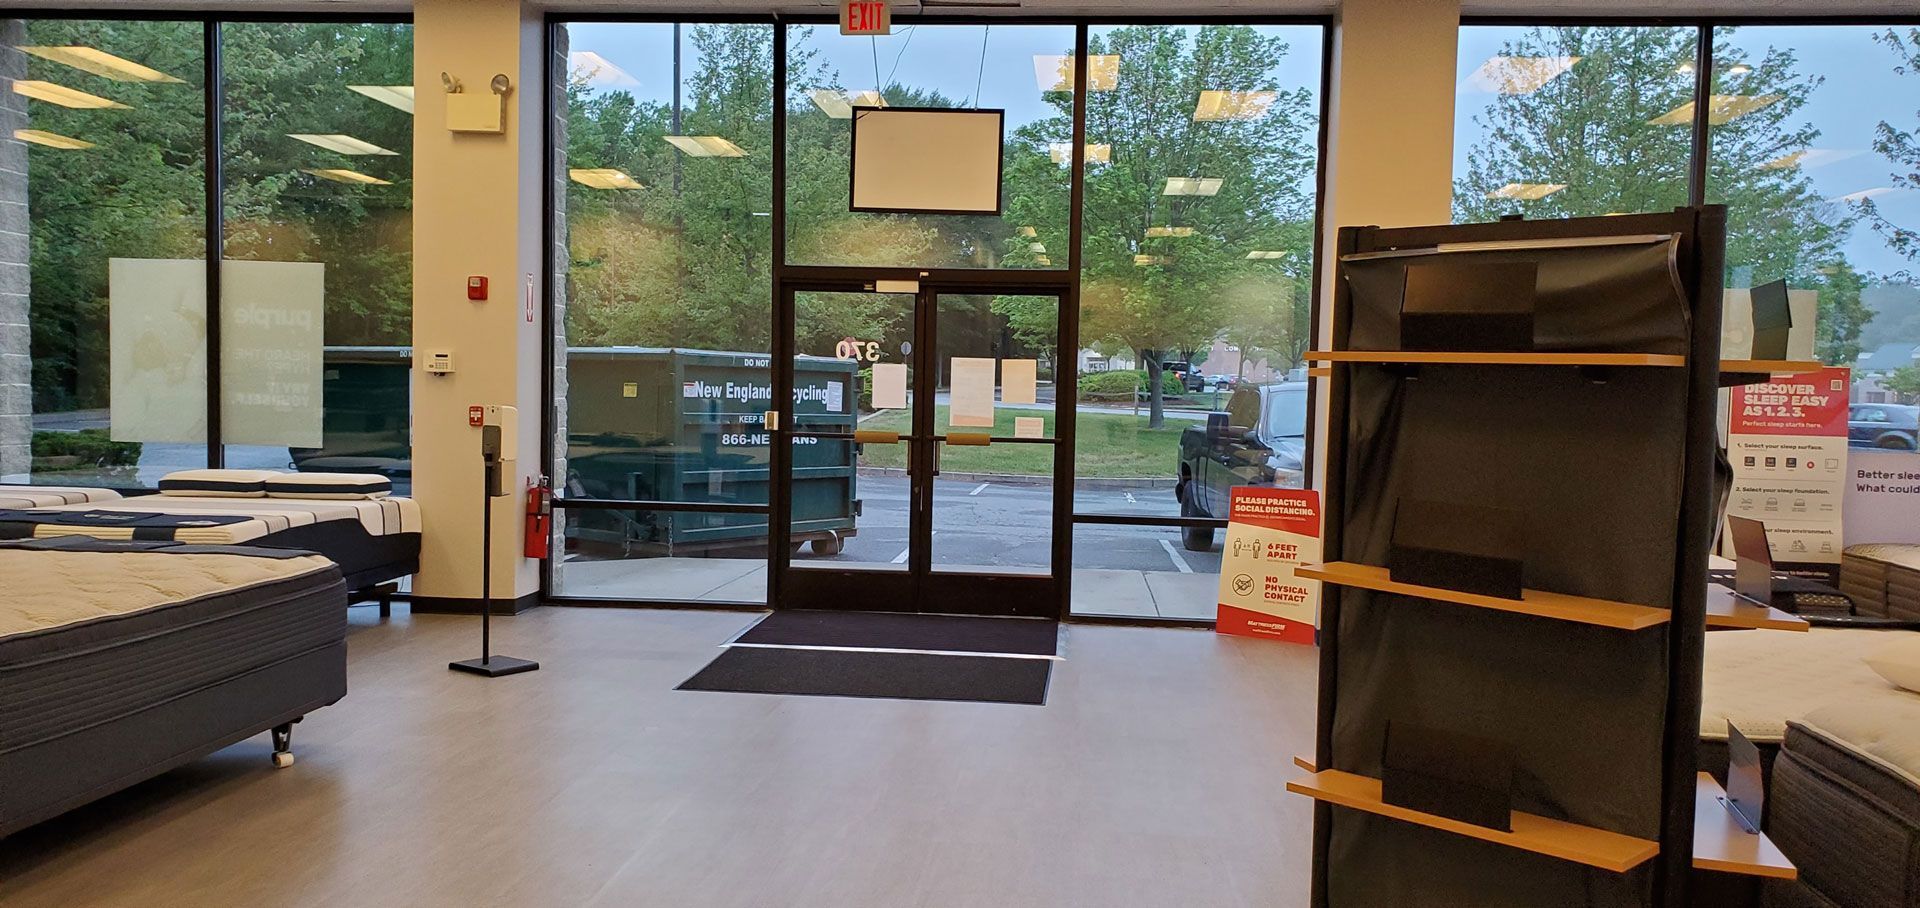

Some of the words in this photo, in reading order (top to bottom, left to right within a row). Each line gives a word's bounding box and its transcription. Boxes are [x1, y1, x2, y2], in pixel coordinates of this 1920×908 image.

[848, 2, 884, 31] EXIT
[744, 358, 754, 367] DO
[755, 359, 770, 367] NOT
[695, 380, 722, 398] New
[726, 382, 772, 403] England
[793, 386, 829, 405] cycling
[1744, 383, 1815, 395] DISCOVER
[1743, 395, 1788, 406] SLEEP
[1791, 395, 1829, 407] EASY
[1742, 405, 1763, 416] AS
[1764, 406, 1775, 417] 1.
[1776, 406, 1791, 417] 2.
[1791, 407, 1806, 418] 3.
[739, 415, 758, 424] KEEP
[721, 433, 818, 445] 866-NEANS
[1857, 469, 1896, 480] Better
[1897, 471, 1920, 480] slee
[1856, 483, 1886, 493] What
[1888, 485, 1920, 494] could
[1235, 496, 1267, 505] PLEASE
[1267, 498, 1307, 507] PRACTICE
[1234, 504, 1265, 513] SOCIAL
[1265, 506, 1316, 516] DISTANCING.
[1774, 527, 1791, 535] sleep
[1275, 543, 1298, 552] FEET
[1266, 551, 1298, 560] APART
[1265, 575, 1278, 584] NO
[1264, 583, 1309, 596] PHYSICAL
[1264, 591, 1306, 603] CONTACT
